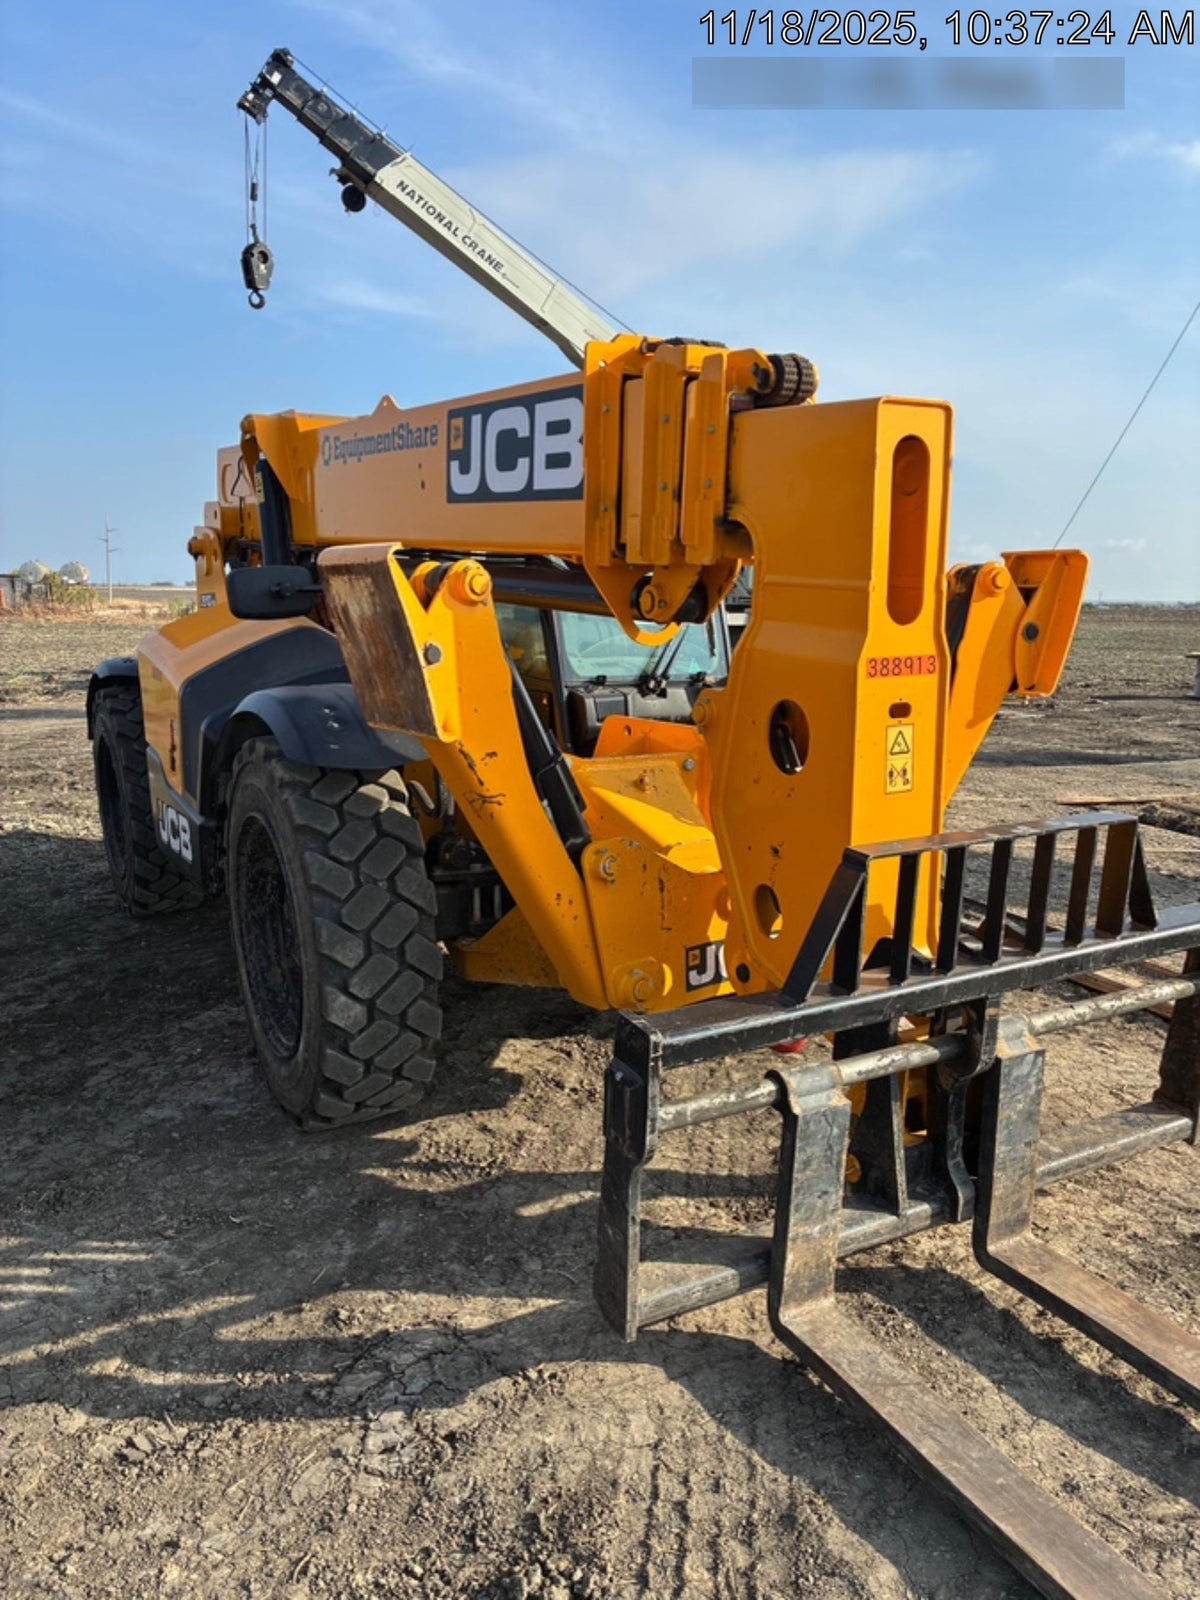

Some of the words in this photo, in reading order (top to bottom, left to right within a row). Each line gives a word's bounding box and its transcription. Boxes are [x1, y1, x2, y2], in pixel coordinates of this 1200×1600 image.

[396, 180, 460, 238] NATIONAL
[461, 235, 504, 273] CRANE
[333, 422, 440, 463] EquipmentShare
[450, 397, 584, 495] JCB
[868, 655, 936, 678] 388913
[158, 801, 193, 864] JCB
[688, 943, 728, 986] J
